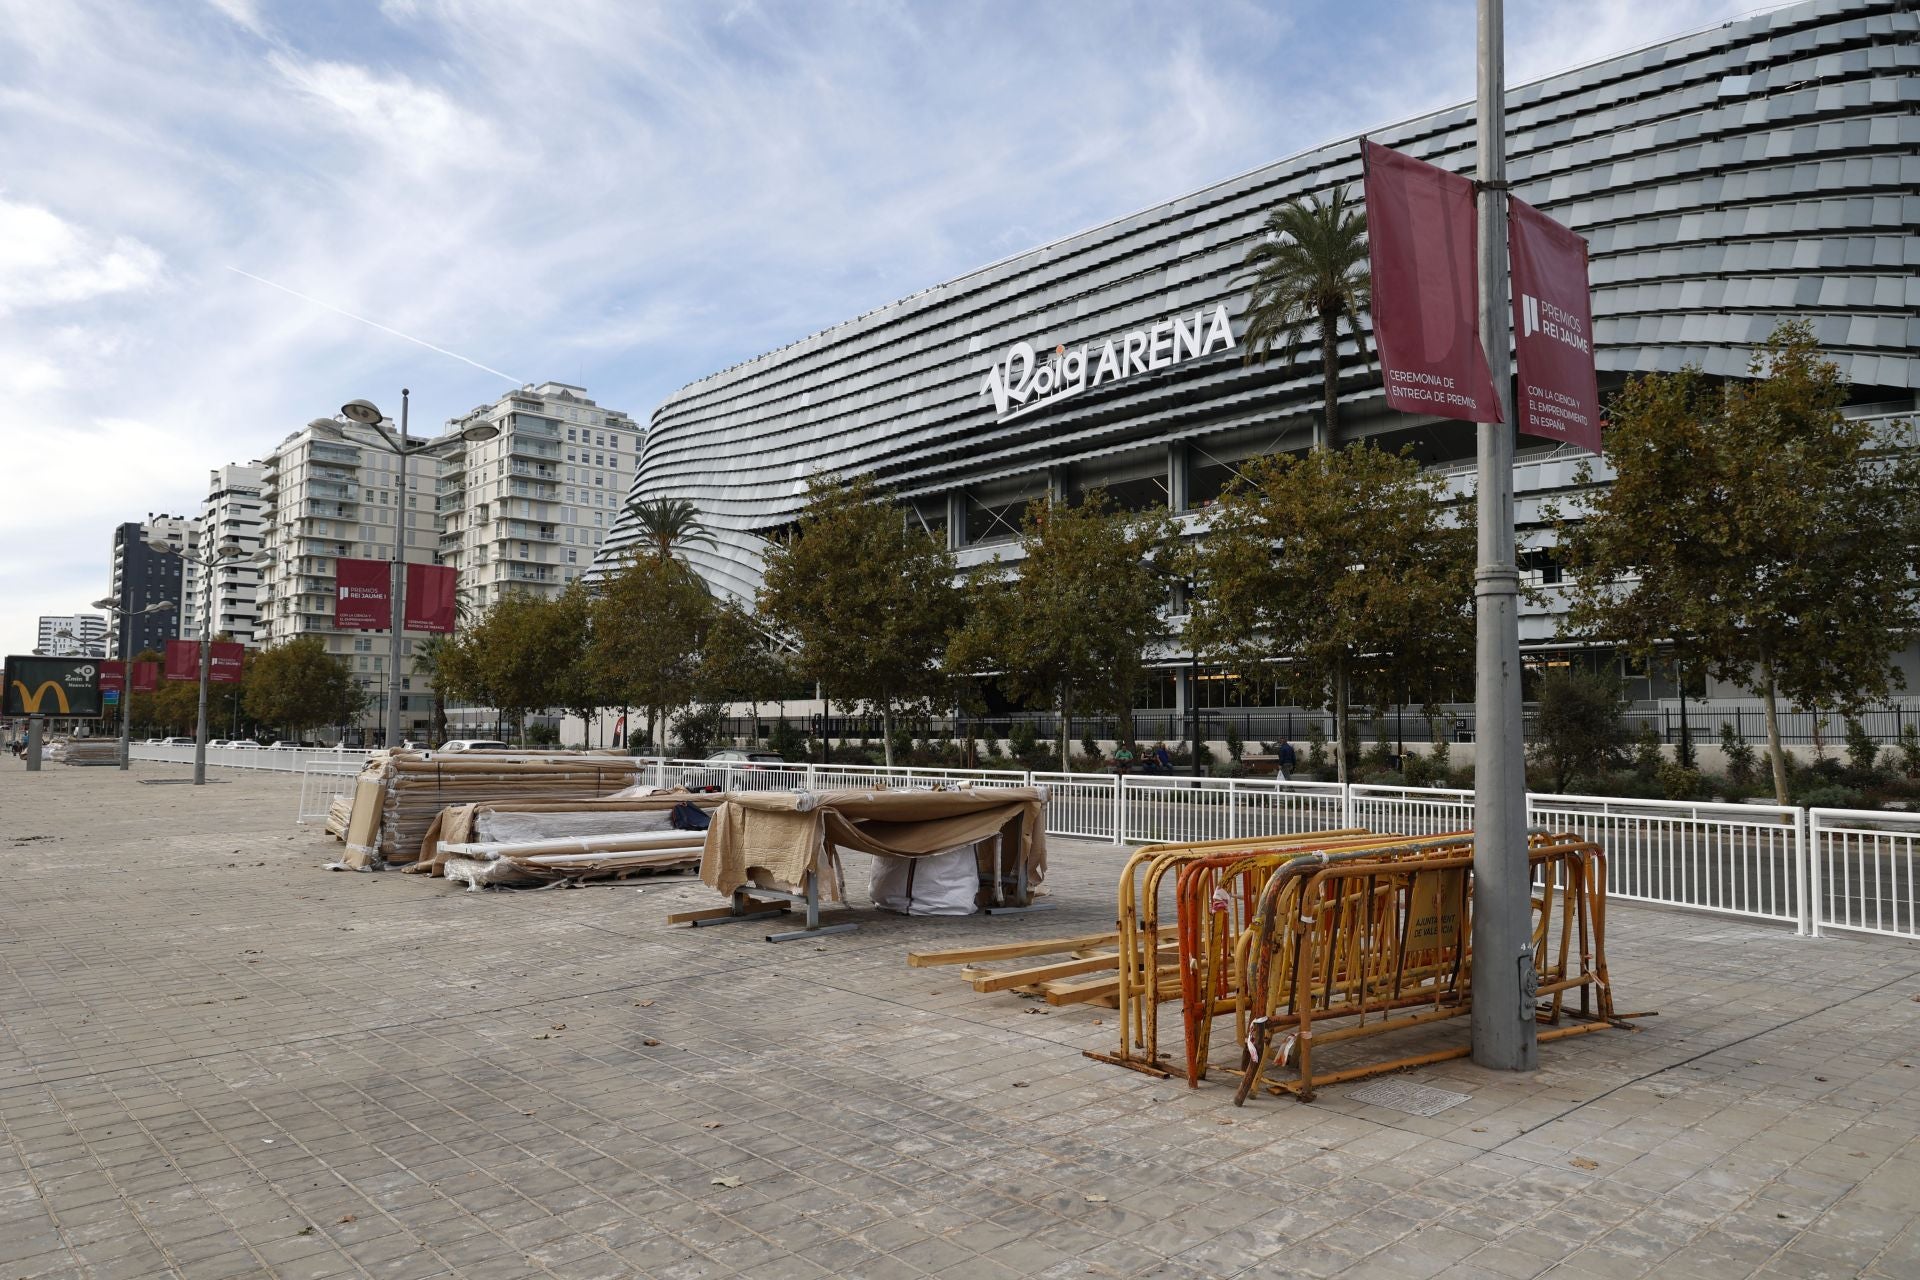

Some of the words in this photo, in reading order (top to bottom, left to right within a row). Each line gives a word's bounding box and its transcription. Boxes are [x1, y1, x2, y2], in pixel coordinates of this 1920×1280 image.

[1541, 300, 1582, 333] PREMIOS
[1542, 319, 1559, 340] REI
[1560, 327, 1589, 354] JAUME
[980, 341, 1089, 424] Roig
[1092, 305, 1237, 387] ARENA
[1389, 369, 1442, 387] CEREMONIA
[1443, 376, 1455, 389] DE
[1391, 385, 1433, 401] ENTREGA
[1433, 391, 1445, 403] DE
[1528, 385, 1544, 398] CON
[1544, 389, 1554, 401] LA
[1554, 392, 1576, 409] CIENCIA
[1576, 402, 1581, 410] Y
[1529, 399, 1537, 411] EL
[1529, 414, 1540, 425] EN
[1540, 416, 1567, 432] ESPAÑA
[64, 674, 83, 682] 2min
